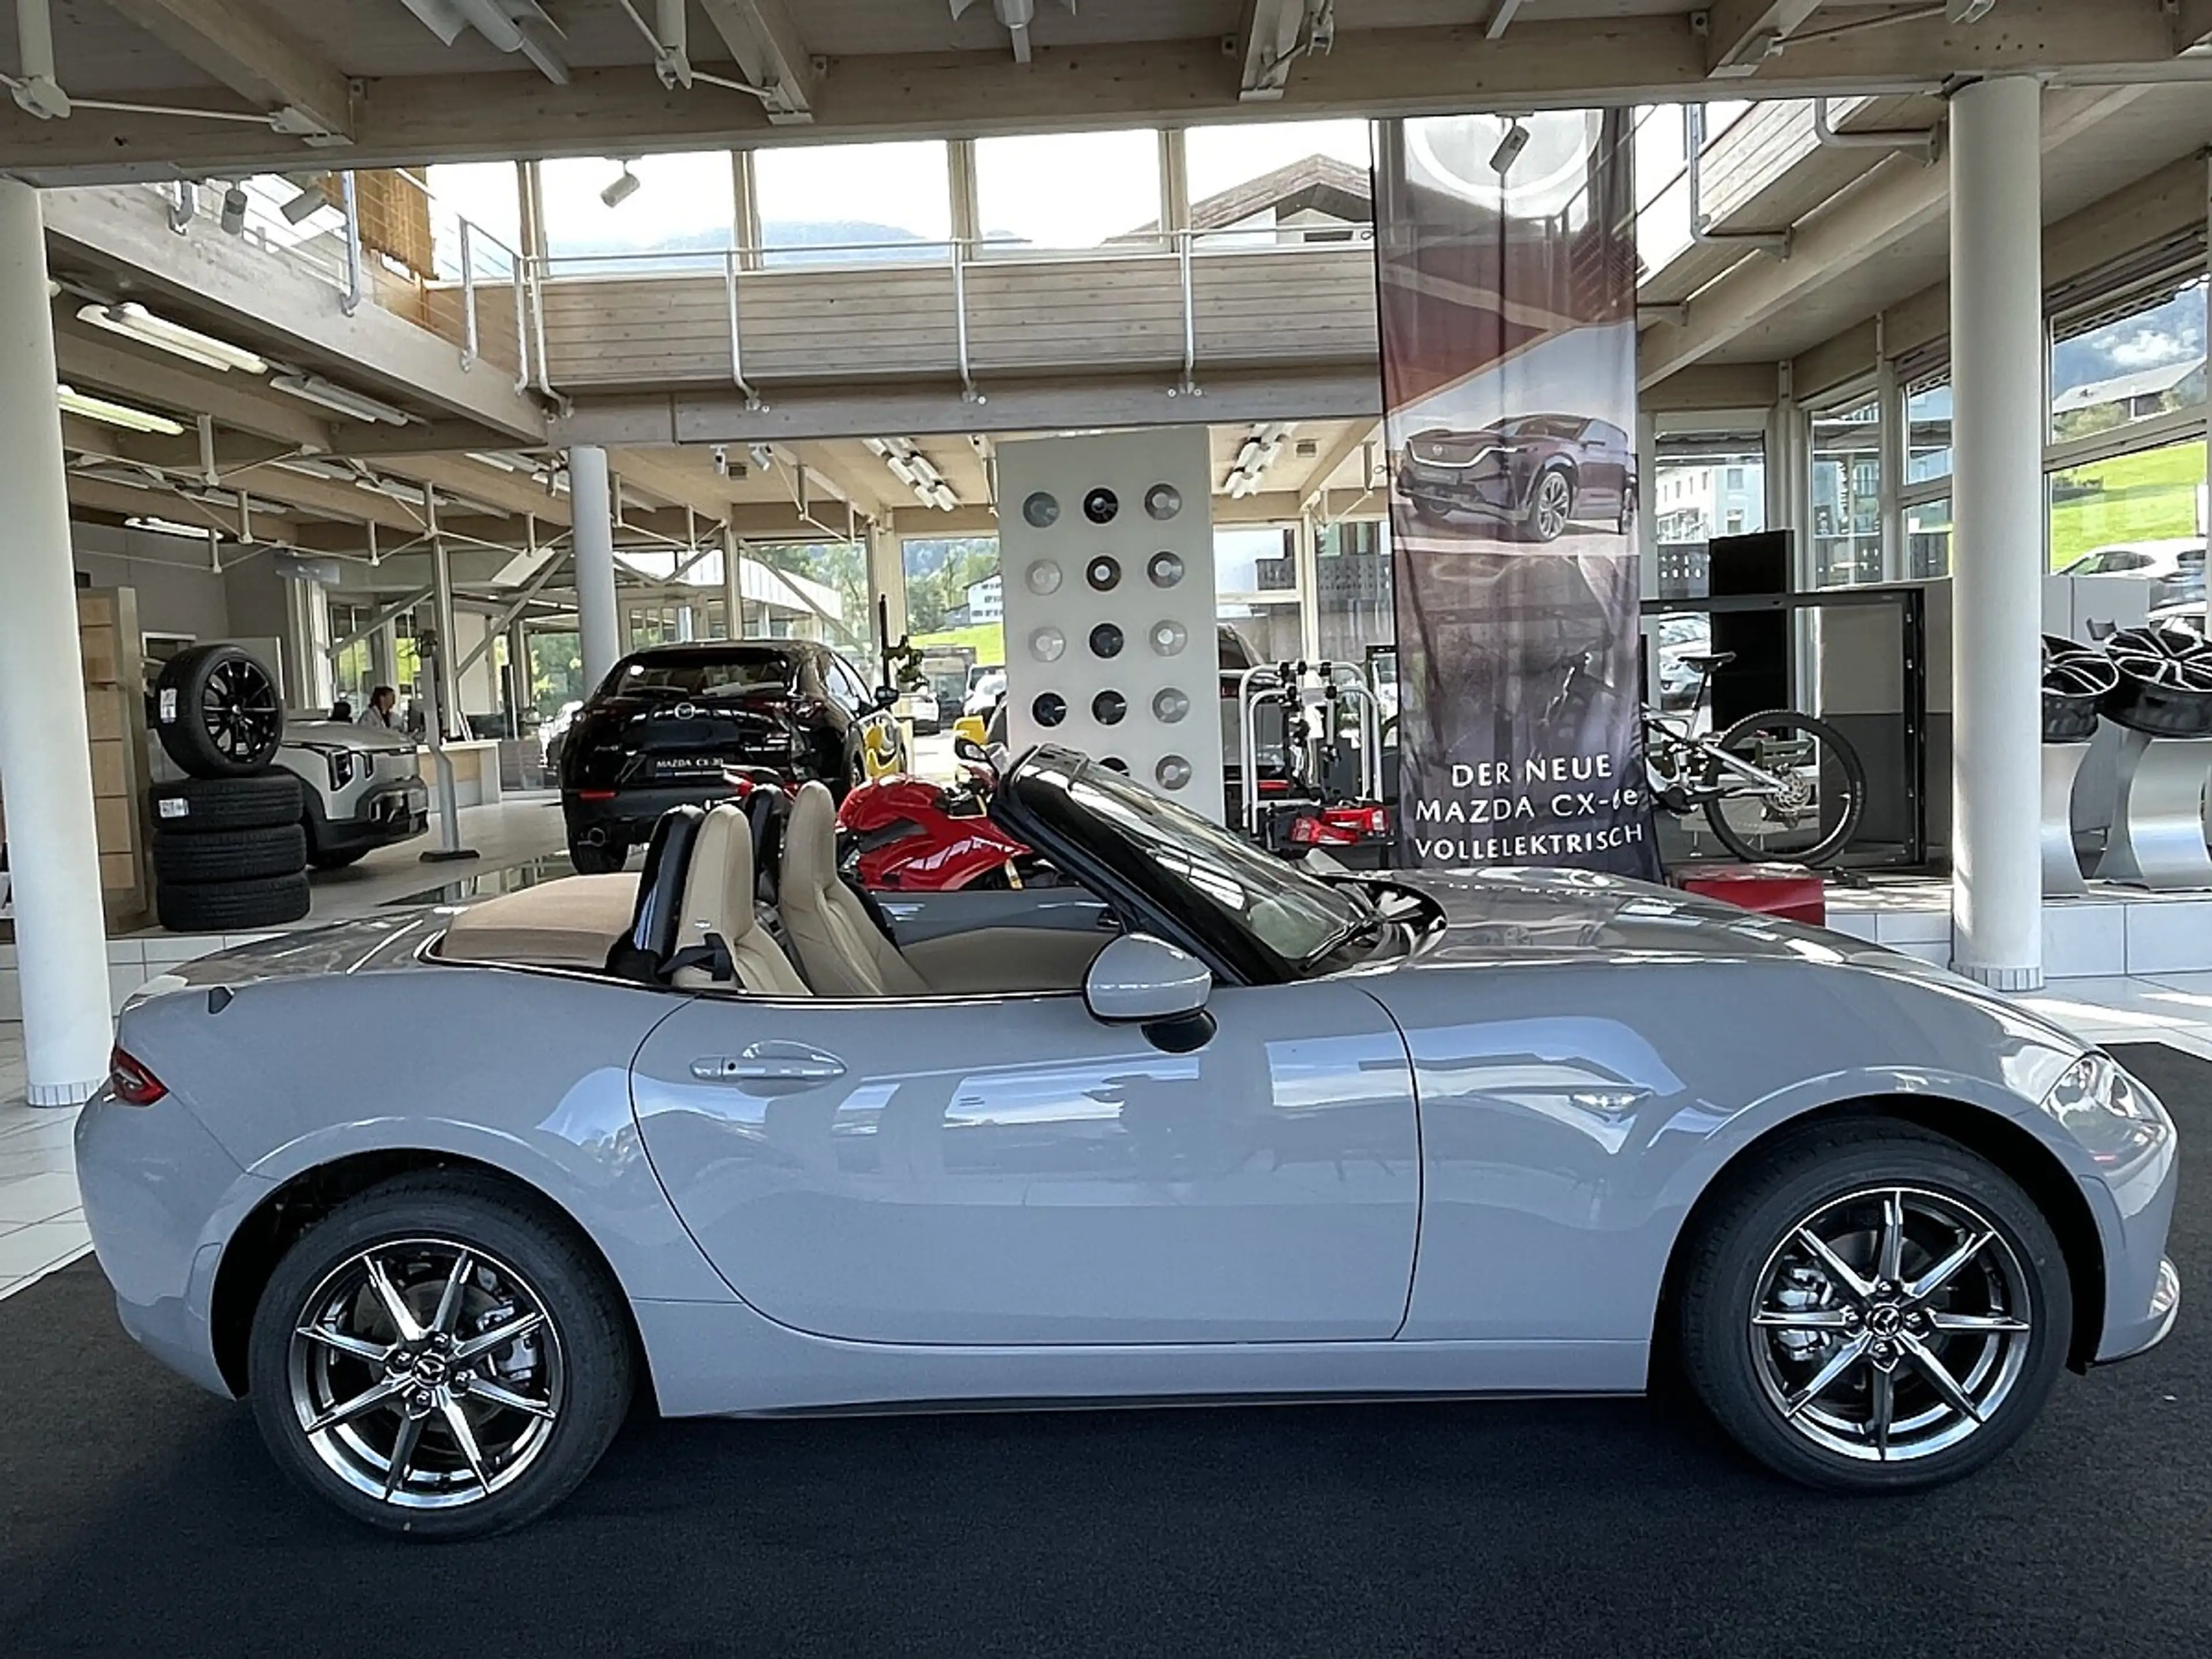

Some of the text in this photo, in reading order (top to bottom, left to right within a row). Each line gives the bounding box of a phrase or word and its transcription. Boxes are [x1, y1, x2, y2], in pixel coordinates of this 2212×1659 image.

[657, 759, 692, 768] MAZDA
[1452, 753, 1612, 787] DER NEUE
[1415, 796, 1535, 824] MAZDA
[1414, 823, 1643, 861] VOLLELEKTRISCH
